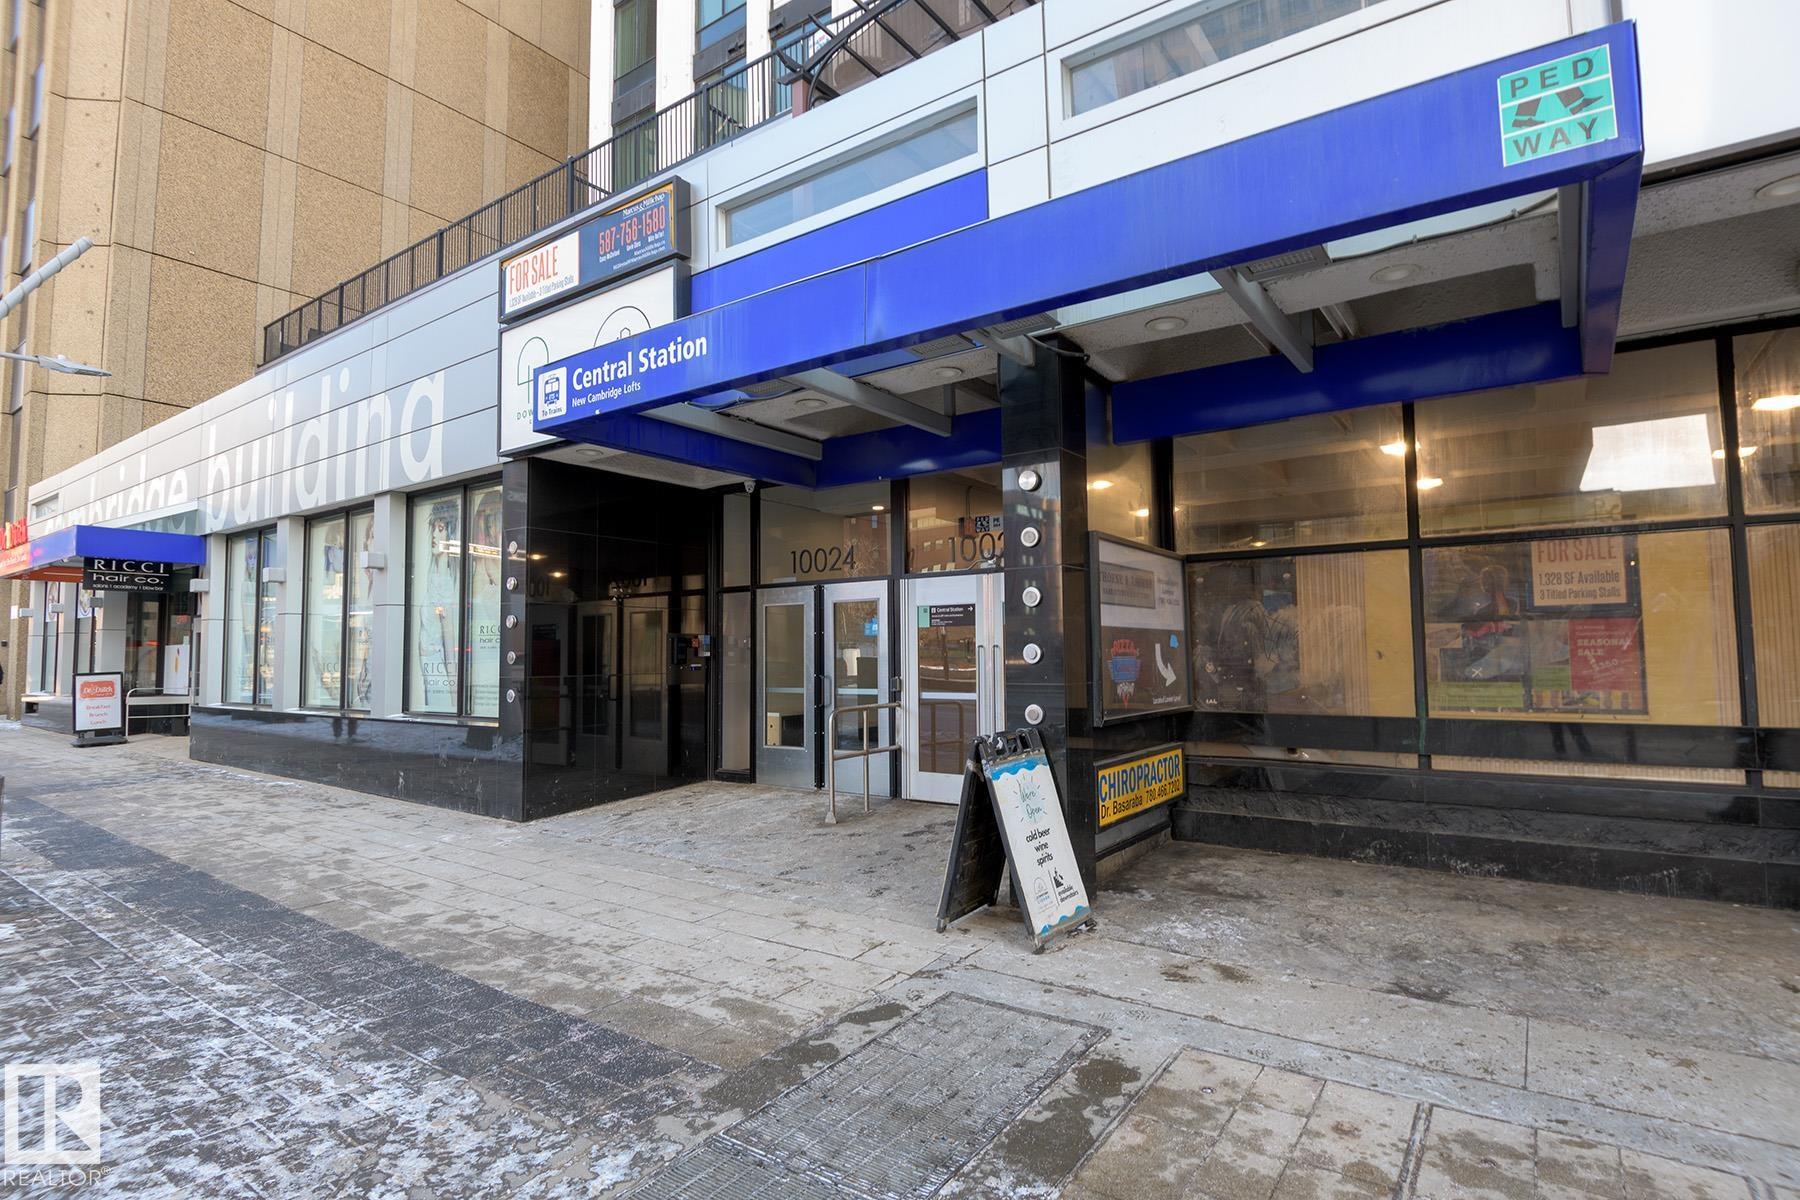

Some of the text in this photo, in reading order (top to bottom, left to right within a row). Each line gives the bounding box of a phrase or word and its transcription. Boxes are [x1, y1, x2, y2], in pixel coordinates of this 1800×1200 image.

[1510, 57, 1594, 98] PED
[1512, 117, 1598, 158] WAY
[509, 245, 559, 295] FOR SALE
[572, 336, 707, 391] Central Station
[571, 397, 587, 408] New
[587, 386, 622, 404] Cambridge
[623, 380, 641, 394] Lofts
[790, 544, 857, 574] 10024
[1537, 537, 1617, 562] FOR SALE
[94, 558, 165, 574] RICCI
[1563, 571, 1575, 585] SF
[1577, 569, 1620, 584] Available
[93, 573, 164, 585] hair co.
[1568, 587, 1598, 600] Parking
[1598, 586, 1621, 598] Stalls
[1100, 754, 1181, 803] CHIROPRACTOR
[1101, 804, 1112, 819] Dr.
[1113, 794, 1143, 815] Basaraba
[1025, 827, 1051, 843] cold beer
[1033, 840, 1049, 853] wine
[1036, 851, 1054, 868] spirits
